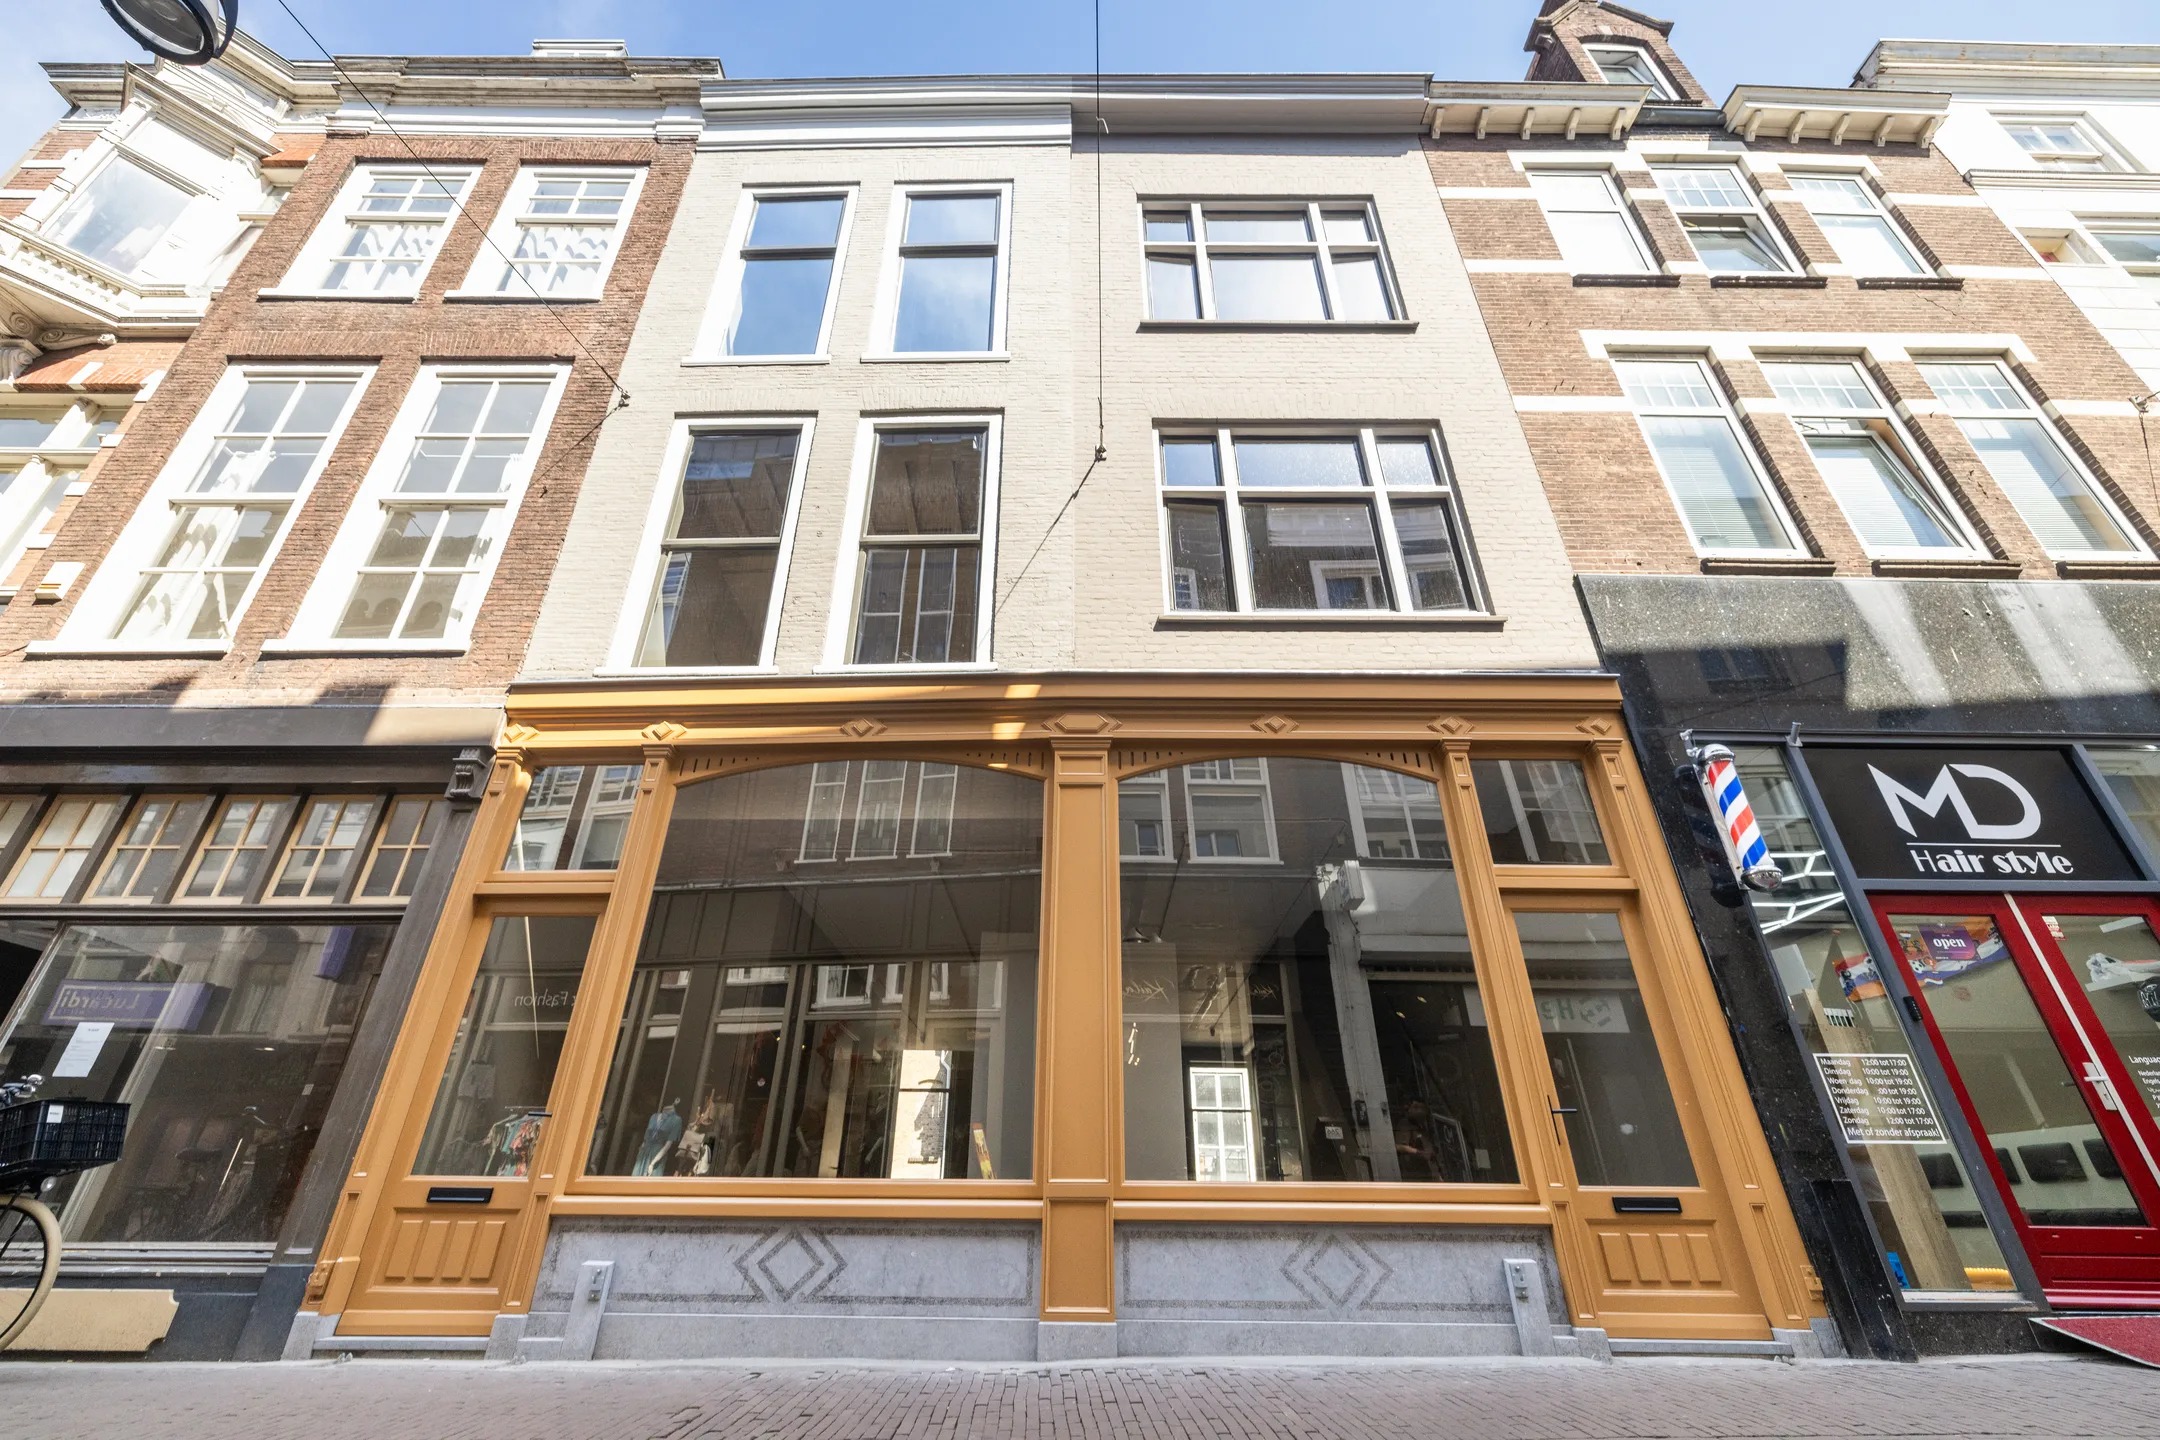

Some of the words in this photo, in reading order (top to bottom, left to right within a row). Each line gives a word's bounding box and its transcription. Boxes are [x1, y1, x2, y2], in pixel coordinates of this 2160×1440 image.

[1867, 763, 2041, 839] MD
[1910, 849, 1984, 873] Hair
[1992, 851, 2074, 874] style
[1933, 938, 1966, 950] open
[1820, 1058, 1851, 1067] Maandag
[1861, 1058, 1879, 1066] 12:00
[1823, 1068, 1851, 1076] Dinsdag
[1891, 1068, 1909, 1076] 19:00
[1866, 1077, 1884, 1085] 10:00
[1831, 1087, 1869, 1096] Donderdag
[1834, 1096, 1859, 1105] Vrijdag
[1903, 1097, 1921, 1105] 19:00
[1840, 1106, 1869, 1116] Zaterdag
[1907, 1107, 1925, 1115] 17:00
[1843, 1116, 1870, 1125] Zondag
[1886, 1117, 1904, 1125] 12:00
[1915, 1117, 1934, 1125] 17:00
[1847, 1127, 1865, 1136] Met
[1865, 1127, 1874, 1136] of
[1875, 1127, 1903, 1137] zonder
[1904, 1127, 1940, 1138] afspraak!
